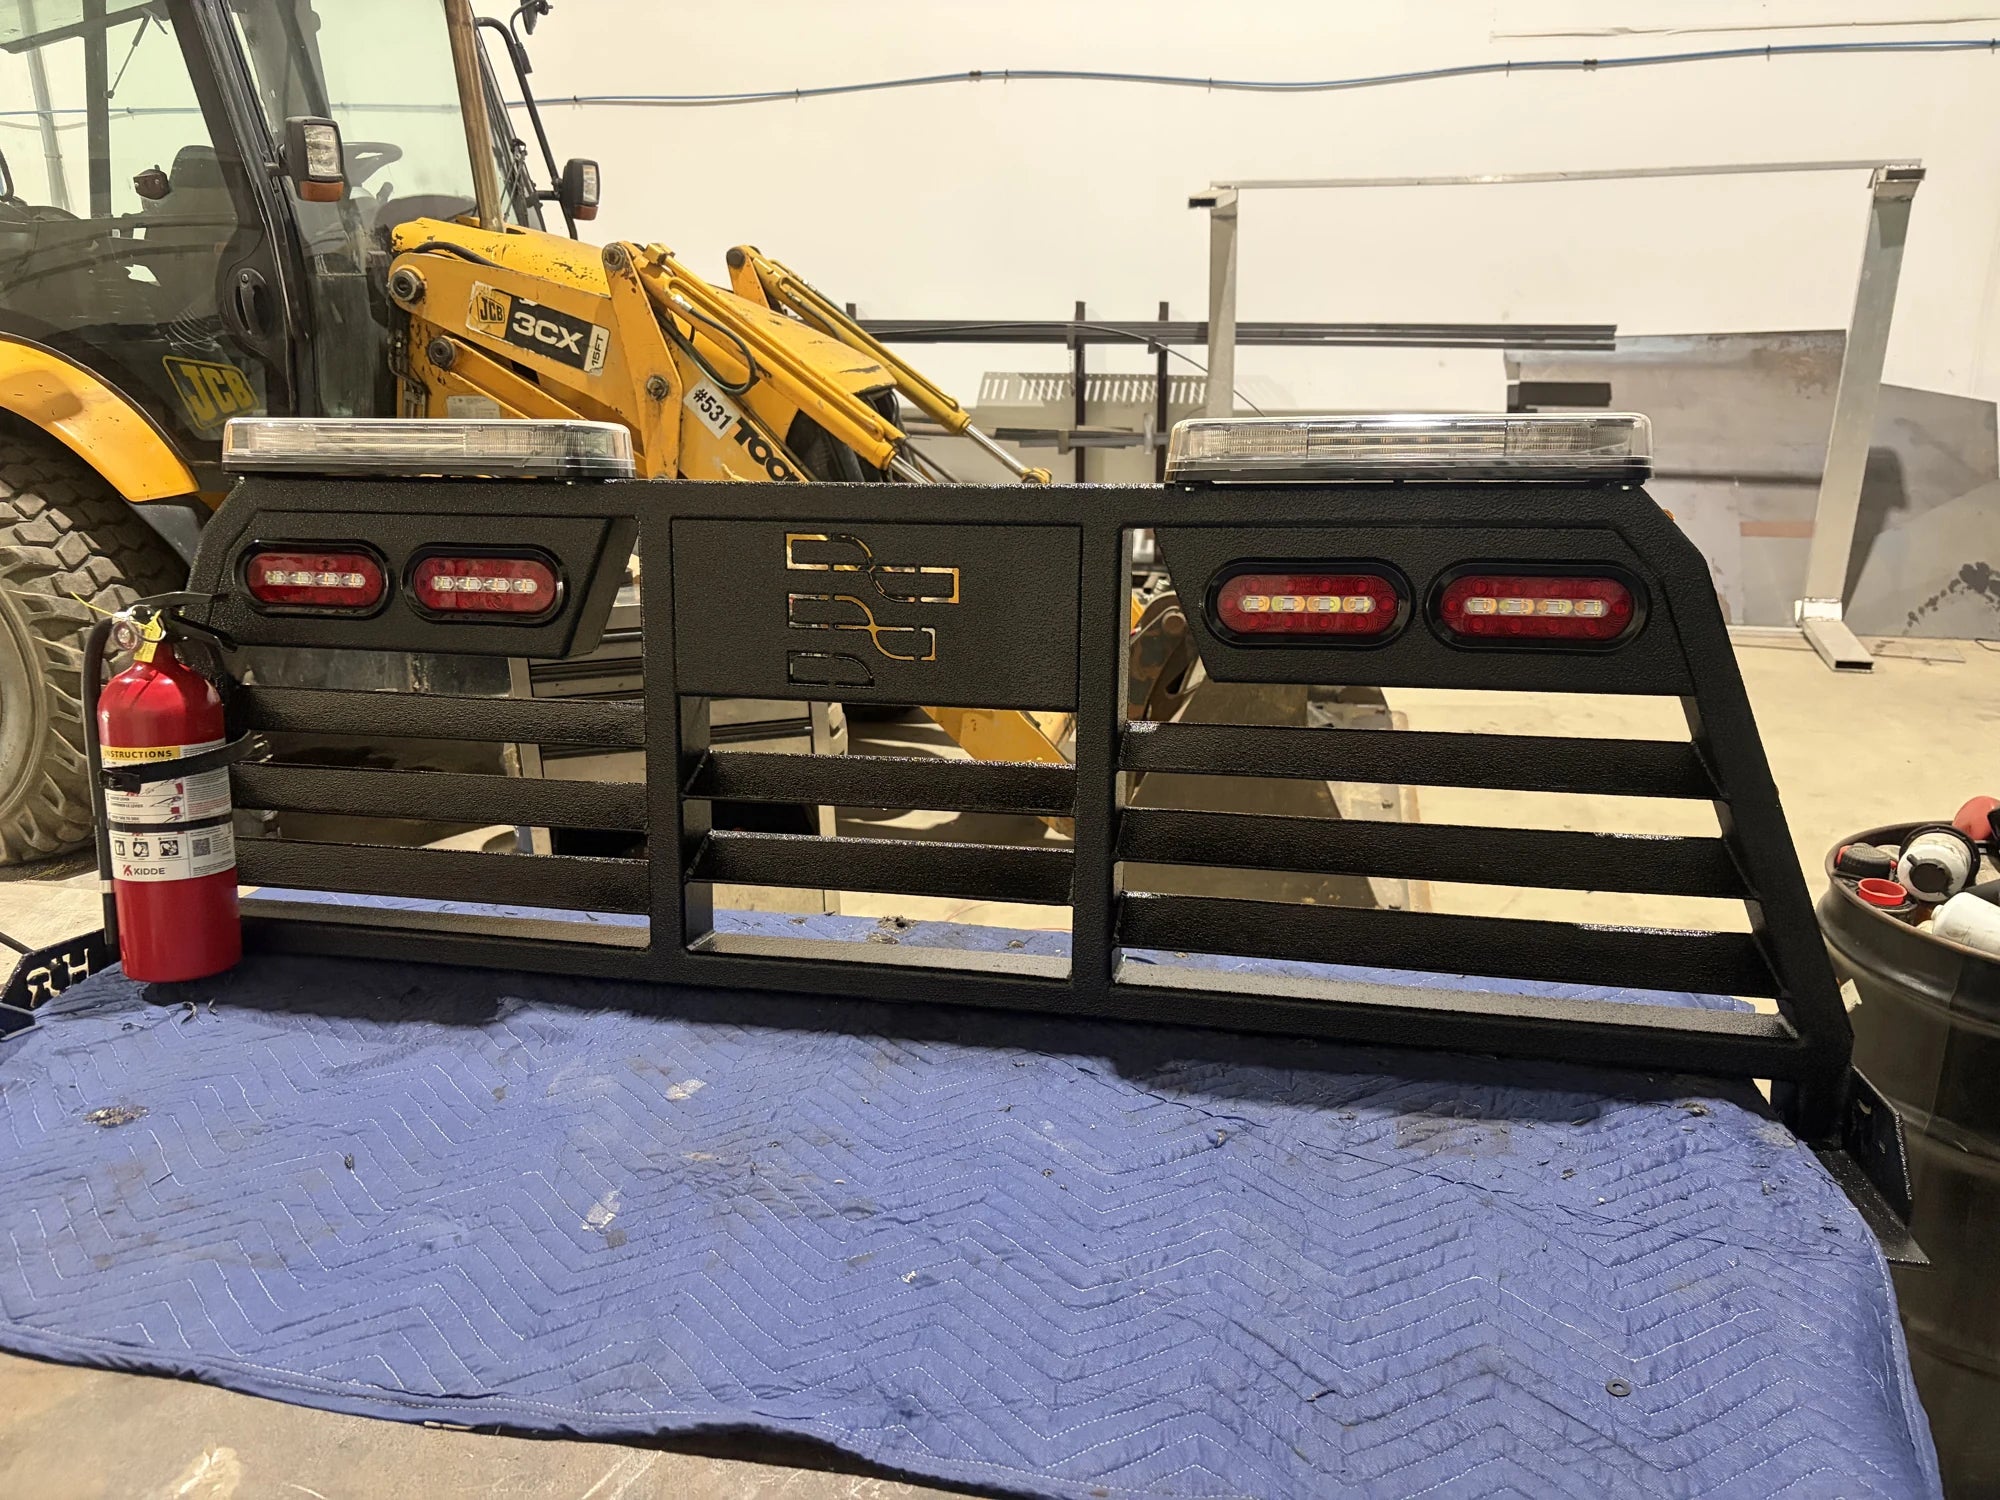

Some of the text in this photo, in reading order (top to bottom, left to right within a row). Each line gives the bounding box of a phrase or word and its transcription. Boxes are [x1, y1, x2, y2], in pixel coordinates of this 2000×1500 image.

[480, 297, 504, 321] JCB
[512, 311, 584, 355] 3CX
[591, 333, 605, 366] 15FT
[179, 364, 253, 421] JCB
[693, 388, 733, 430] #531
[733, 416, 801, 481] TOO
[133, 867, 165, 875] KIDDE
